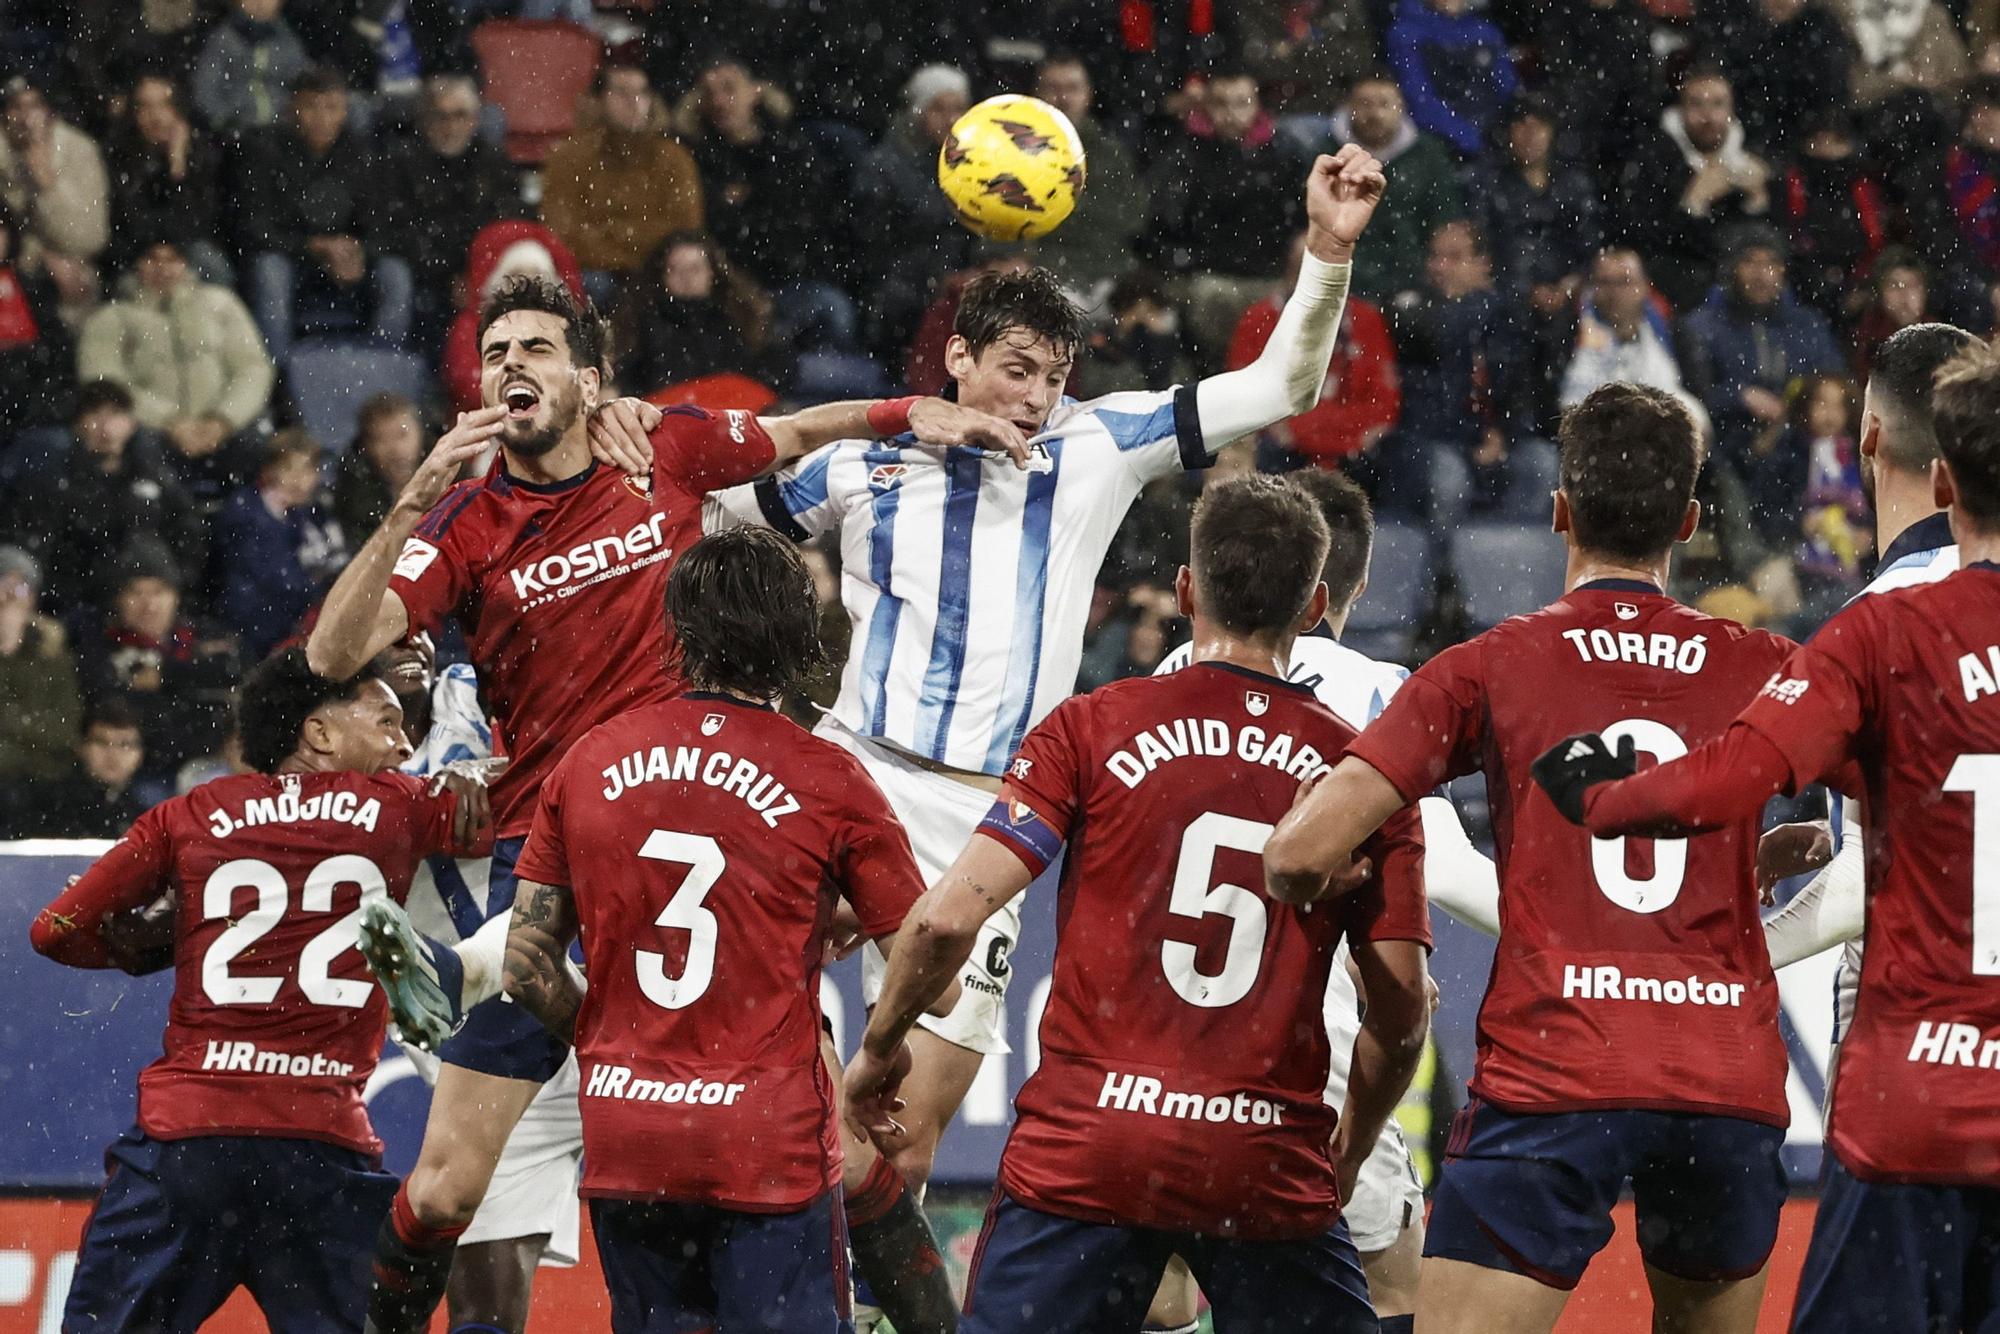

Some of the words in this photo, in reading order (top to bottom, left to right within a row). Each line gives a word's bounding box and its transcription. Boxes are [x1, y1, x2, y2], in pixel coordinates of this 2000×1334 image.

[1562, 629, 1708, 674] TORRÓ
[1105, 718, 1231, 789] DAVID
[602, 746, 702, 801] JUAN
[702, 752, 801, 828] CRUZ
[209, 791, 381, 838] J.MOJICA
[202, 855, 388, 1008] 22
[636, 829, 726, 1010] 3
[1161, 811, 1275, 1007] 5
[1563, 965, 1745, 1007] HRmotor
[202, 1039, 354, 1077] HRmotor
[585, 1064, 745, 1106] HRmotor
[1097, 1071, 1286, 1125] HRmotor
